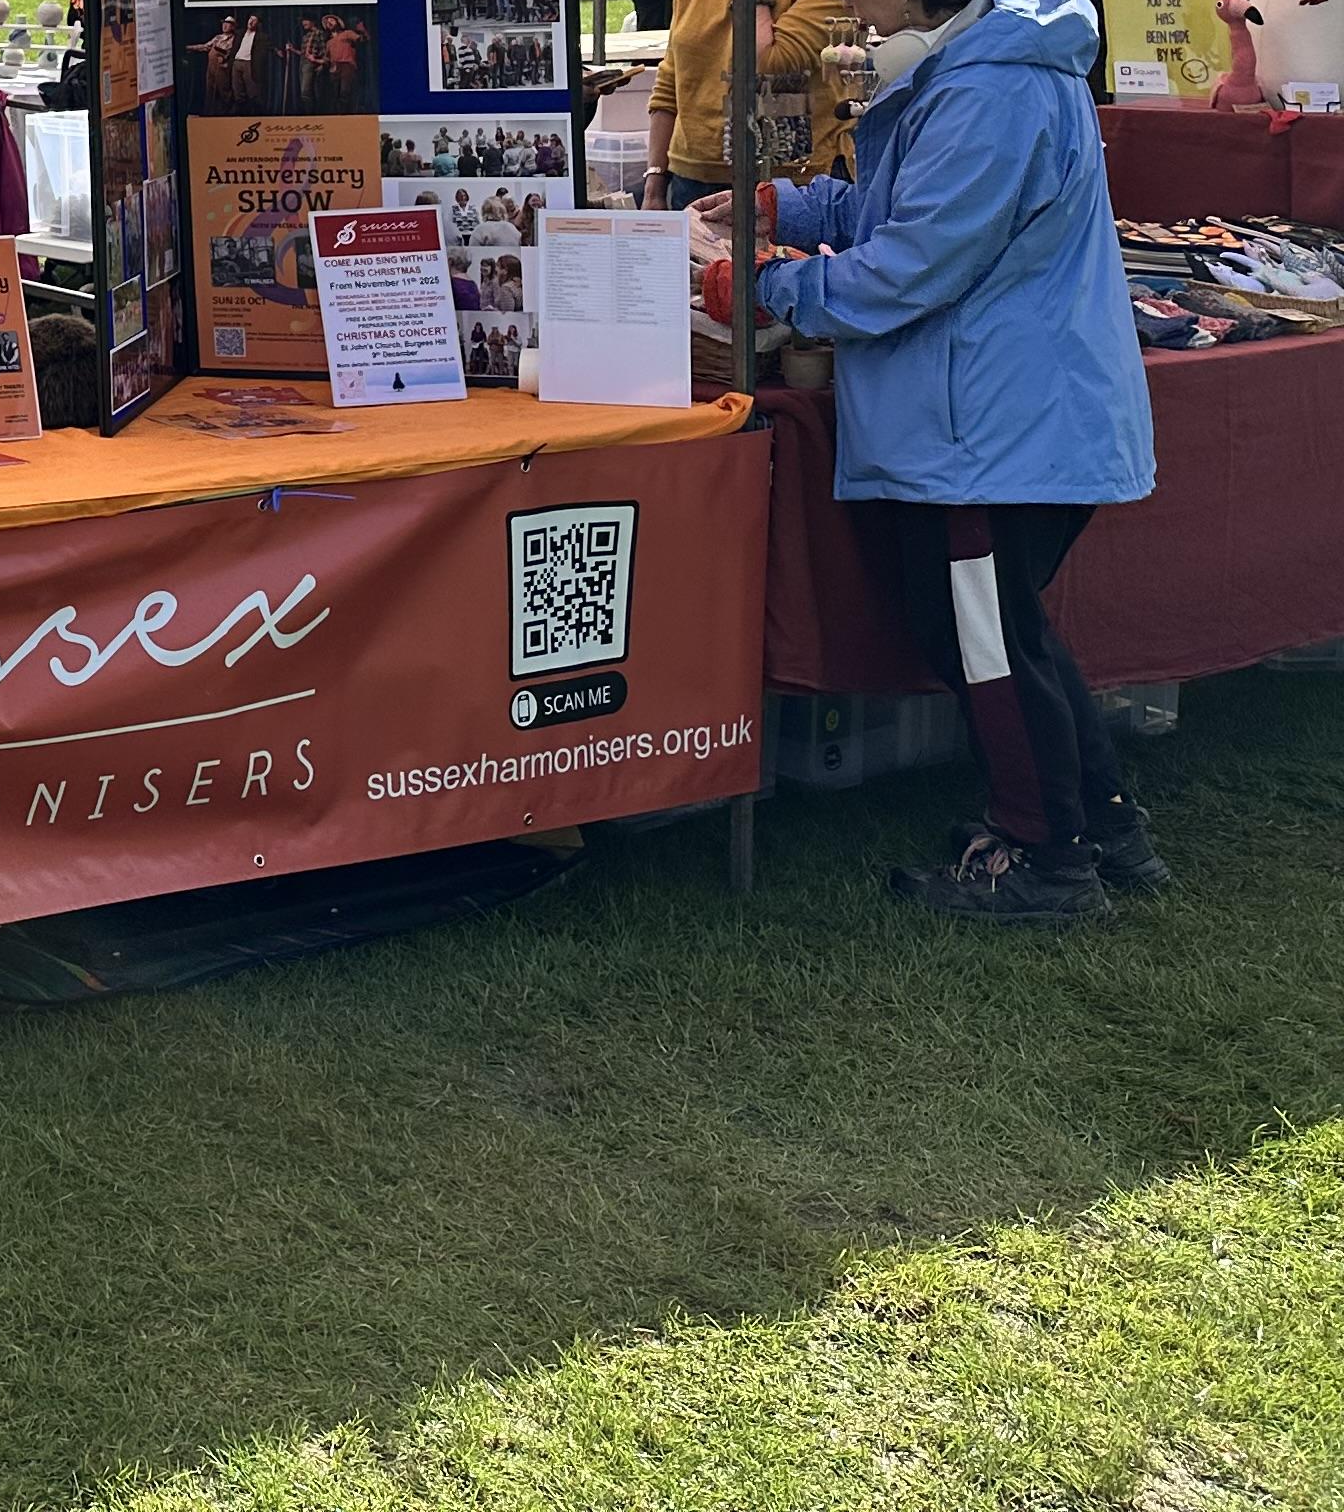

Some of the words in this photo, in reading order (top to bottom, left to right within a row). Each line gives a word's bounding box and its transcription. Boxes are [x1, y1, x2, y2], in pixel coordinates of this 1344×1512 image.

[1156, 13, 1175, 25] HAS
[1146, 31, 1167, 44] BEEN
[1169, 30, 1190, 44] MADE
[1157, 48, 1168, 62] BY
[1171, 48, 1183, 61] ME
[204, 165, 364, 188] Anniversary
[237, 189, 335, 213] SHOW
[359, 220, 419, 231] sussex
[323, 258, 351, 267] COME
[352, 256, 373, 265] AND
[375, 255, 397, 264] SING
[399, 254, 423, 263] WITH
[425, 253, 438, 261] US
[344, 268, 365, 277] THIS
[366, 265, 421, 276] CHRISTMAS
[328, 280, 352, 290] From
[354, 278, 399, 288] November
[418, 276, 440, 285] 2025
[211, 296, 232, 304] SUN
[247, 296, 265, 304] OCT
[335, 329, 396, 341] CHRISTMAS
[398, 326, 448, 337] CONCERT
[349, 342, 373, 350] John's
[374, 340, 402, 349] Church,
[403, 338, 433, 349] Burgess
[382, 349, 418, 358] December
[544, 690, 584, 716] SCAN
[588, 685, 612, 706] ME
[367, 714, 753, 801] sussexharmonisers.org.uk
